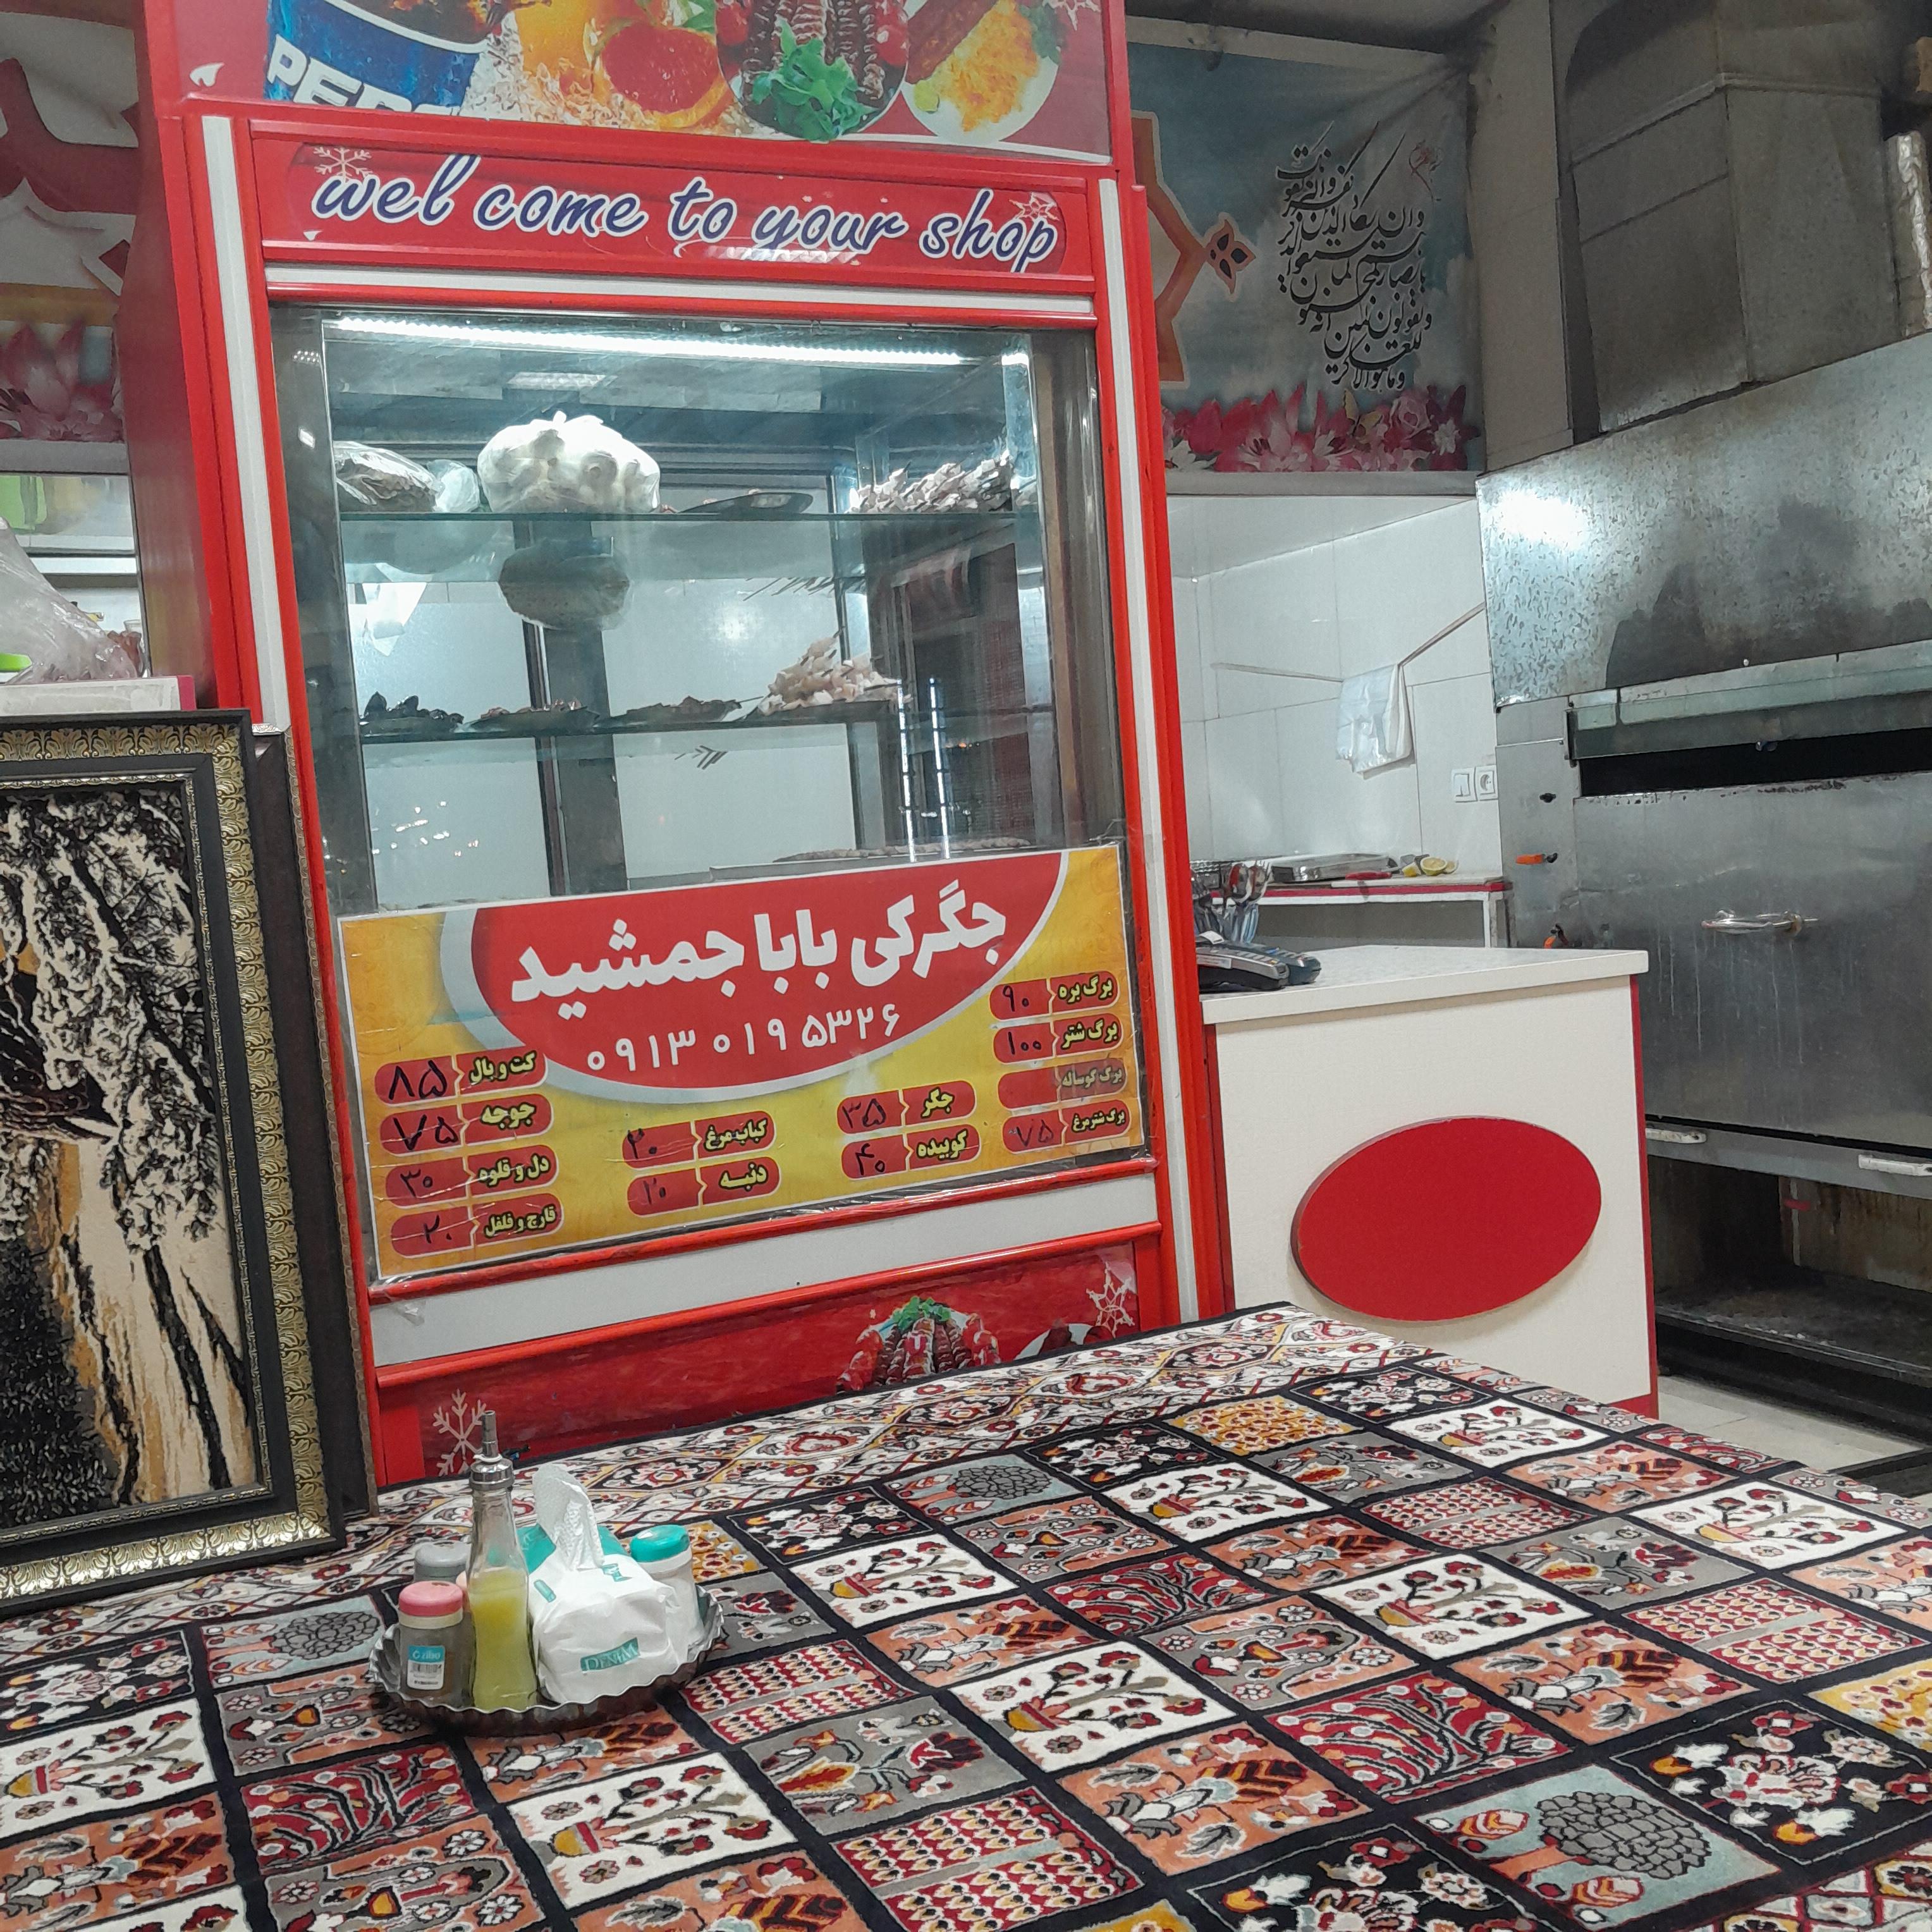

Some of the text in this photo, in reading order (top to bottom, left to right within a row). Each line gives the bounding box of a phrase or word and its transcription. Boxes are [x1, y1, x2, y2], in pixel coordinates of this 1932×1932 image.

[474, 183, 649, 238] come
[668, 176, 737, 243] to
[752, 204, 909, 253] your
[919, 188, 1060, 273] shop
[511, 879, 1006, 1020] جگرکی بابا جمشید
[1058, 982, 1082, 1004] بره
[1082, 974, 1113, 1000] برگ
[1061, 1021, 1085, 1050] شتر
[1087, 1018, 1119, 1044] برگ
[587, 1029, 696, 1072] ۰۹۱۳
[389, 1050, 537, 1100] کت و بال ۸۵
[393, 1102, 537, 1151] جوجه ۷۵
[704, 1124, 733, 1152] مرغ
[735, 1117, 767, 1146] کباب
[916, 1128, 969, 1161] کوبیده
[527, 1153, 551, 1180] دل
[719, 1161, 768, 1192] دنبه
[484, 1211, 515, 1238] فلفل
